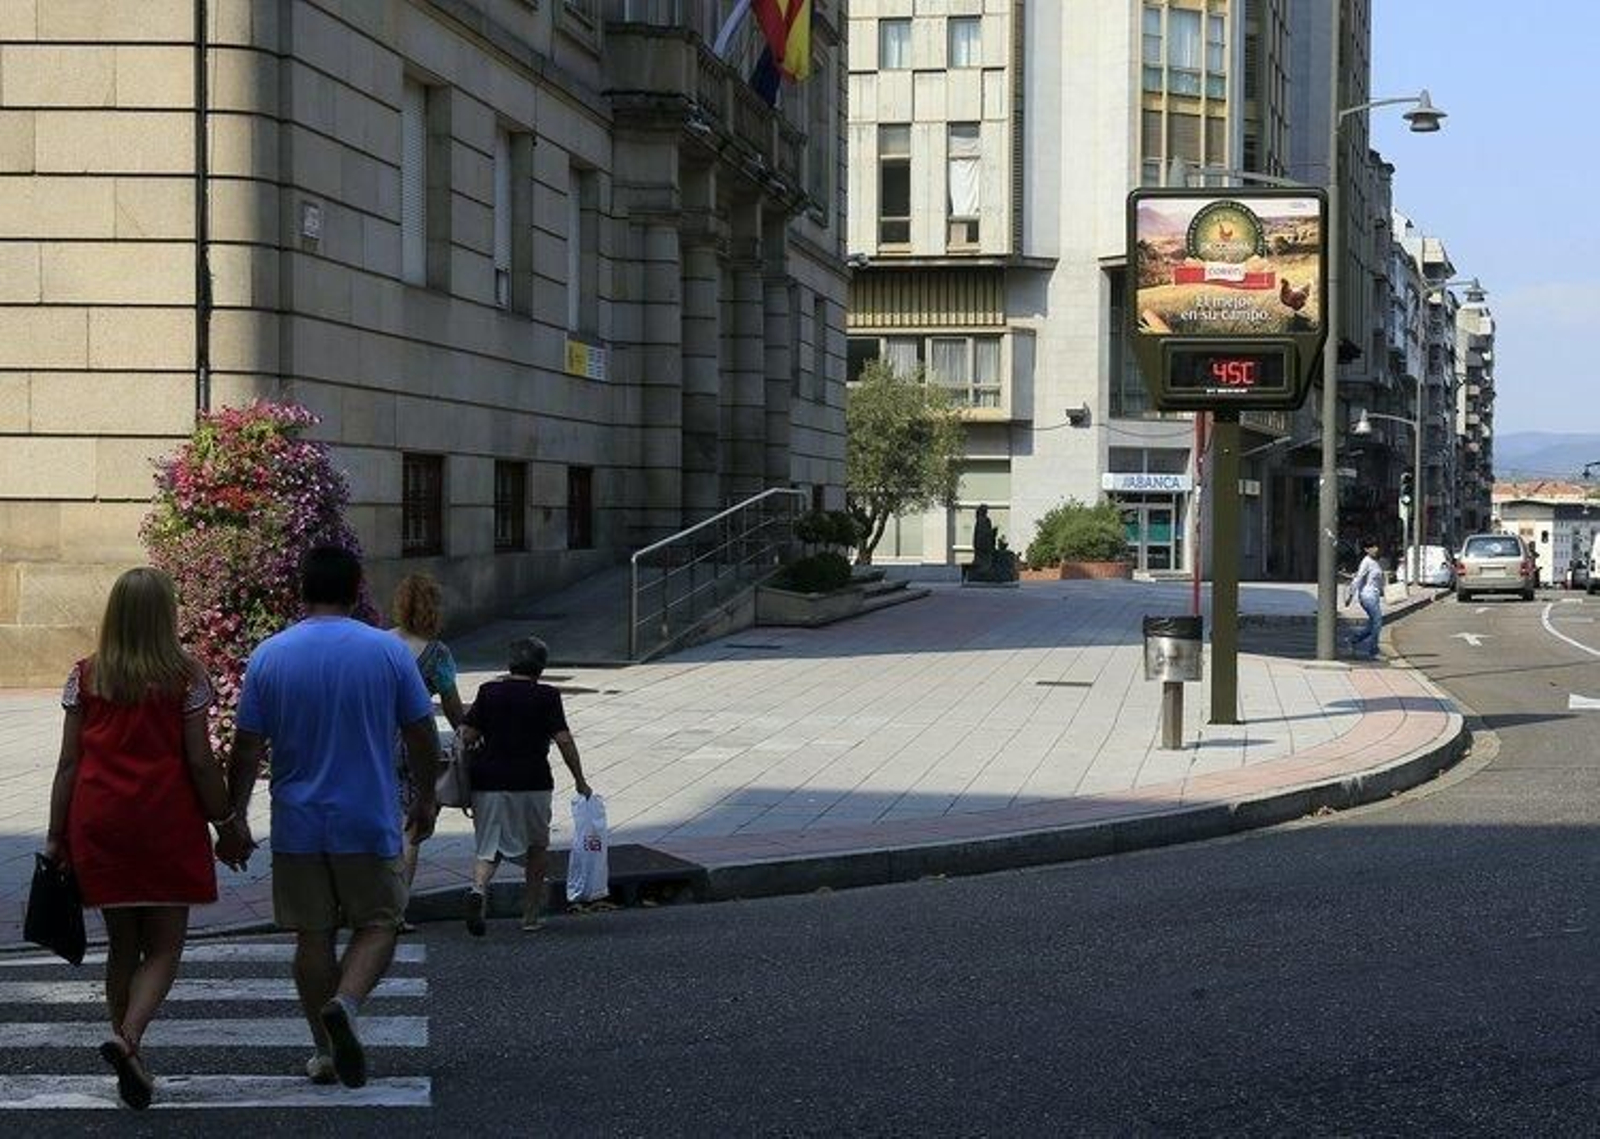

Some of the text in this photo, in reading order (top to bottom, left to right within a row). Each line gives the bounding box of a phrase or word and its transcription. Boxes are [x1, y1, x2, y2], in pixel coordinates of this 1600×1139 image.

[1195, 295, 1252, 309] El mejor
[1180, 310, 1197, 320] en
[1200, 310, 1217, 320] su
[1122, 476, 1181, 489] ABANCA
